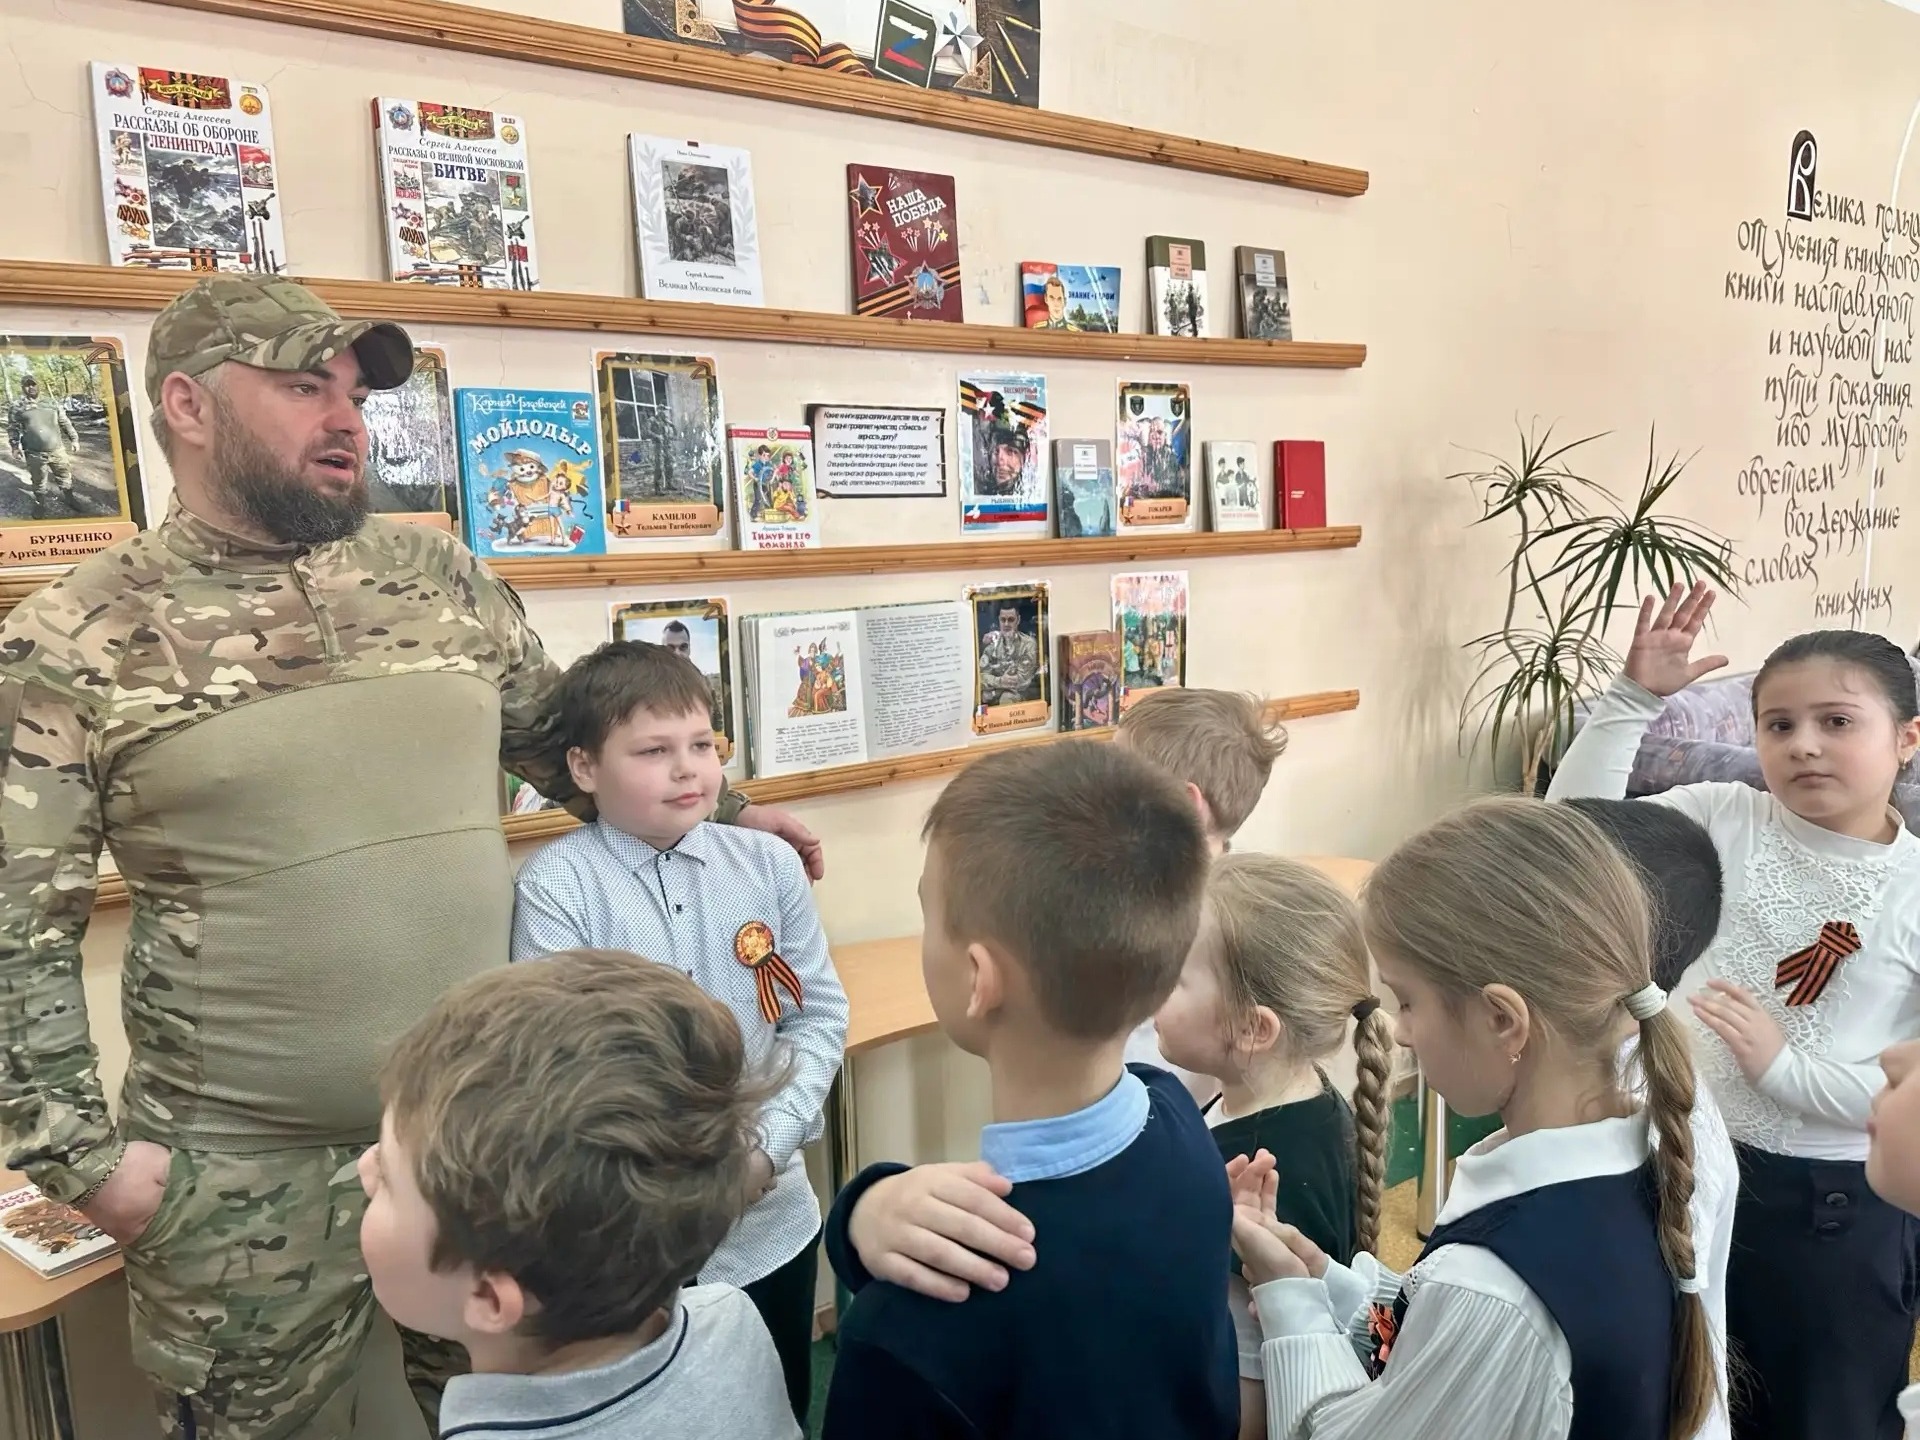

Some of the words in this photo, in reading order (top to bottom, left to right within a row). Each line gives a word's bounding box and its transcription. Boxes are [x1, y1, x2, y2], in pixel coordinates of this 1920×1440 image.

[159, 86, 179, 94] ЧЕСТЬ
[113, 113, 178, 135] РАССКАЗЫ
[182, 122, 199, 137] ОБ
[203, 124, 260, 144] ОБОРОНЕ
[144, 106, 180, 119] Сергей
[183, 111, 231, 125] Алексеев
[149, 134, 232, 158] ЛЕНИНГРАДА
[388, 145, 428, 159] РАССКАЗЫ
[429, 150, 436, 159] О
[437, 151, 473, 165] ВЕЛИКОЙ
[474, 156, 524, 171] МОСКОВСКОЙ
[419, 137, 452, 150] Сергей
[454, 143, 497, 155] Алексеев
[433, 163, 487, 183] БИТВЕ
[1787, 130, 1866, 226] Велика
[886, 188, 927, 214] НАША
[892, 196, 947, 228] ПОБЕДА
[1738, 218, 1780, 271] от
[1775, 218, 1840, 283] учения
[1844, 242, 1919, 292] книжного
[658, 278, 688, 290] Великая
[689, 281, 731, 294] Московская
[1068, 291, 1090, 299] ЗНАНИЕ
[1725, 270, 1784, 304] книги
[1794, 275, 1915, 339] наставляют
[1769, 329, 1782, 355] и
[1788, 322, 1883, 379] научают
[1884, 337, 1912, 363] нас
[466, 392, 514, 415] Корней
[514, 396, 567, 415] Чуковский
[1765, 362, 1819, 420] пути
[469, 418, 592, 455] МОЙДОДЫР
[1777, 411, 1810, 447] ибо
[1821, 411, 1908, 478] мудрость
[1738, 455, 1835, 520] обретаем
[1873, 467, 1884, 489] и
[652, 512, 697, 521] КАМИЛОВ
[1785, 498, 1900, 559] воздержание
[30, 531, 112, 545] БУРЯЧЕНКО
[9, 550, 46, 560] Артём
[1745, 542, 1819, 596] словах
[1814, 578, 1892, 630] книжных
